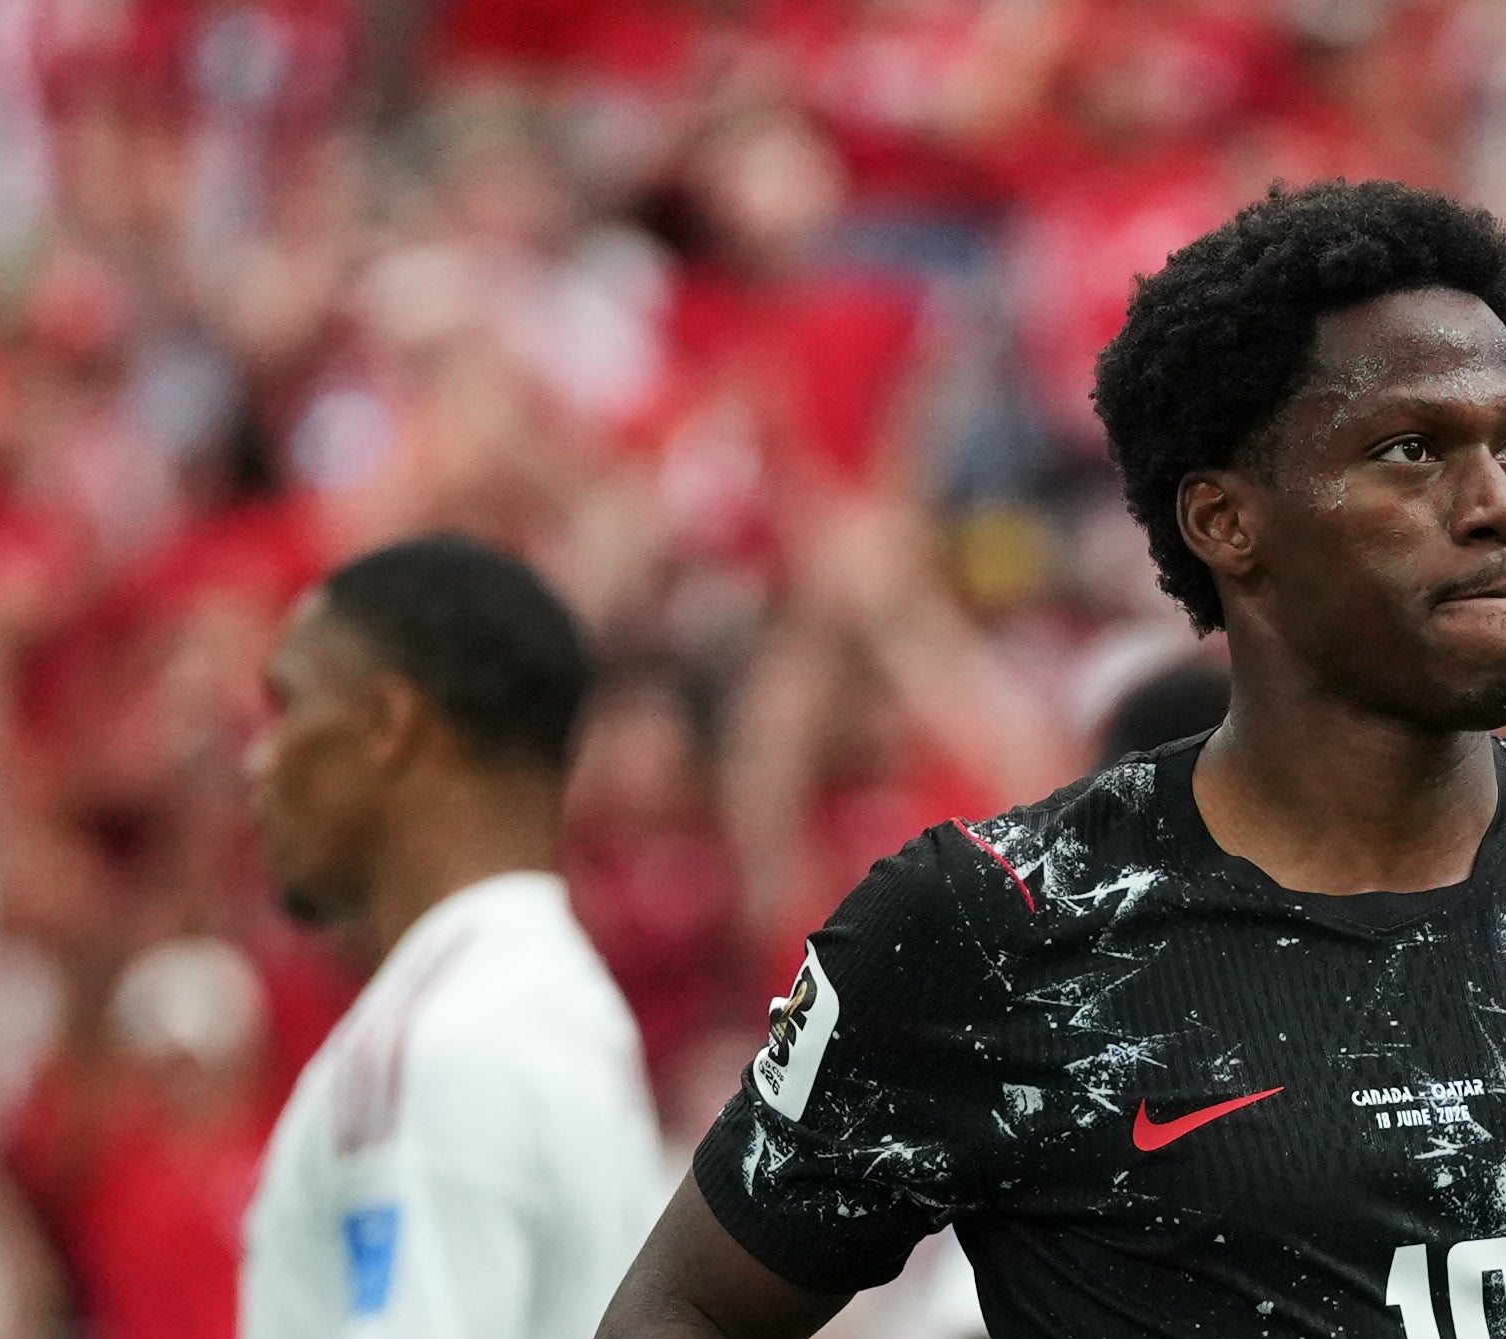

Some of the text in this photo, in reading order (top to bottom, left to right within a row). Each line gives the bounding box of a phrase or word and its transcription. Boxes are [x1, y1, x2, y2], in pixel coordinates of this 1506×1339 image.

[1351, 1086, 1414, 1107] CANADA
[1431, 1078, 1485, 1100] QATAR
[1375, 1105, 1471, 1129] 18 JUNE 2026
